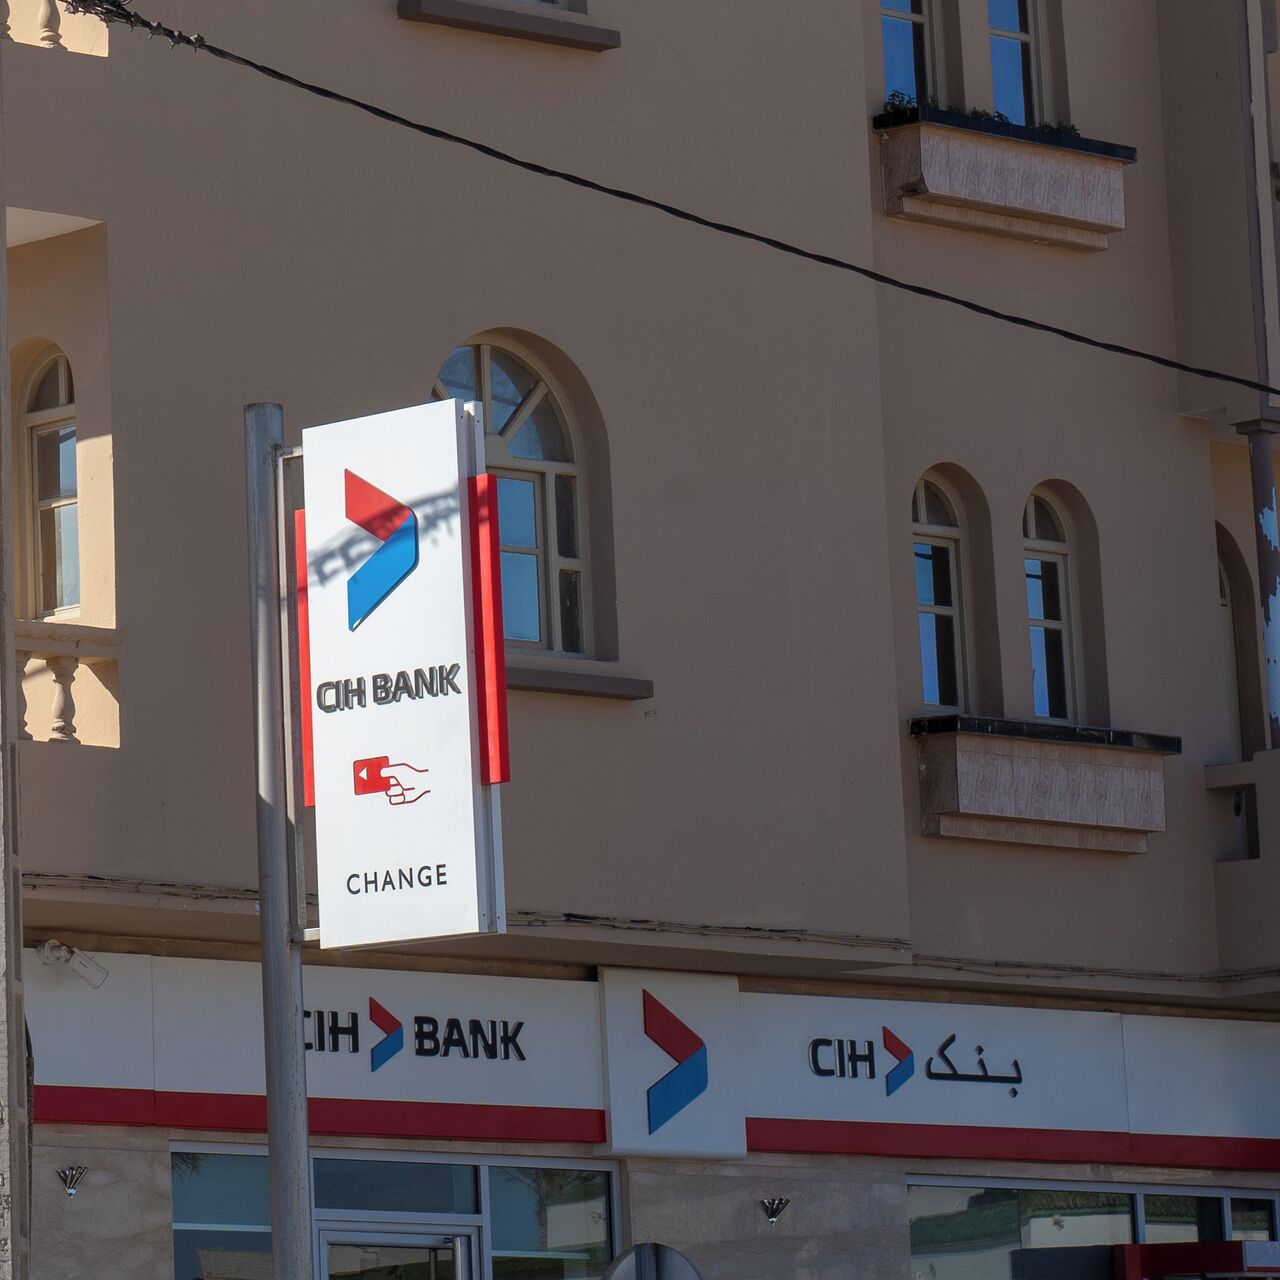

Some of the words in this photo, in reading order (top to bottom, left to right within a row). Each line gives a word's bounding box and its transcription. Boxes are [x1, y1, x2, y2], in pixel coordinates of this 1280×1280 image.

[316, 675, 367, 713] CIH
[372, 662, 462, 706] BANK
[346, 863, 447, 896] CHANGE
[414, 1015, 526, 1062] BANK
[808, 1037, 876, 1080] CIH
